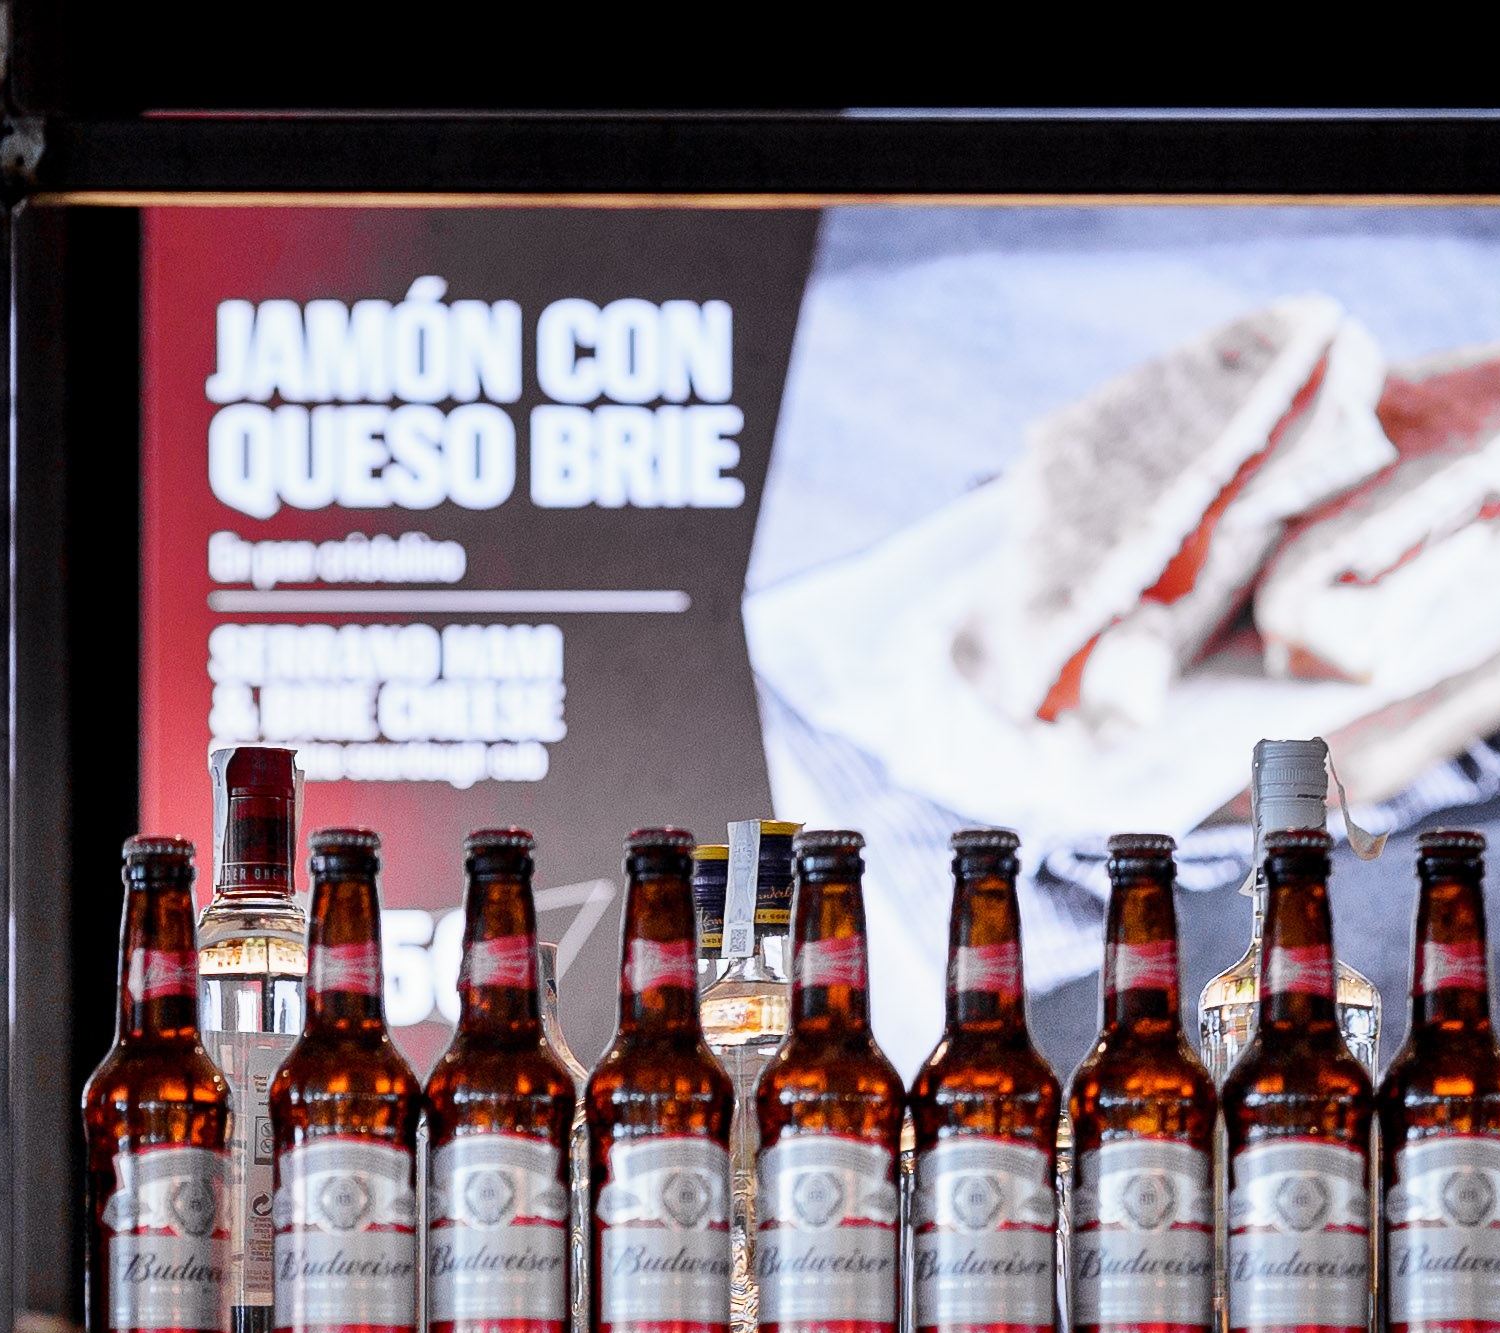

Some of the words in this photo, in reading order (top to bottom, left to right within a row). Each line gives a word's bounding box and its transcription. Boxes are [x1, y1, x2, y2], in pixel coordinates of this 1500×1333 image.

[206, 275, 522, 404] JAMÓN
[536, 299, 733, 404] CON
[208, 404, 516, 519] QUESO
[530, 404, 745, 509] BRIE
